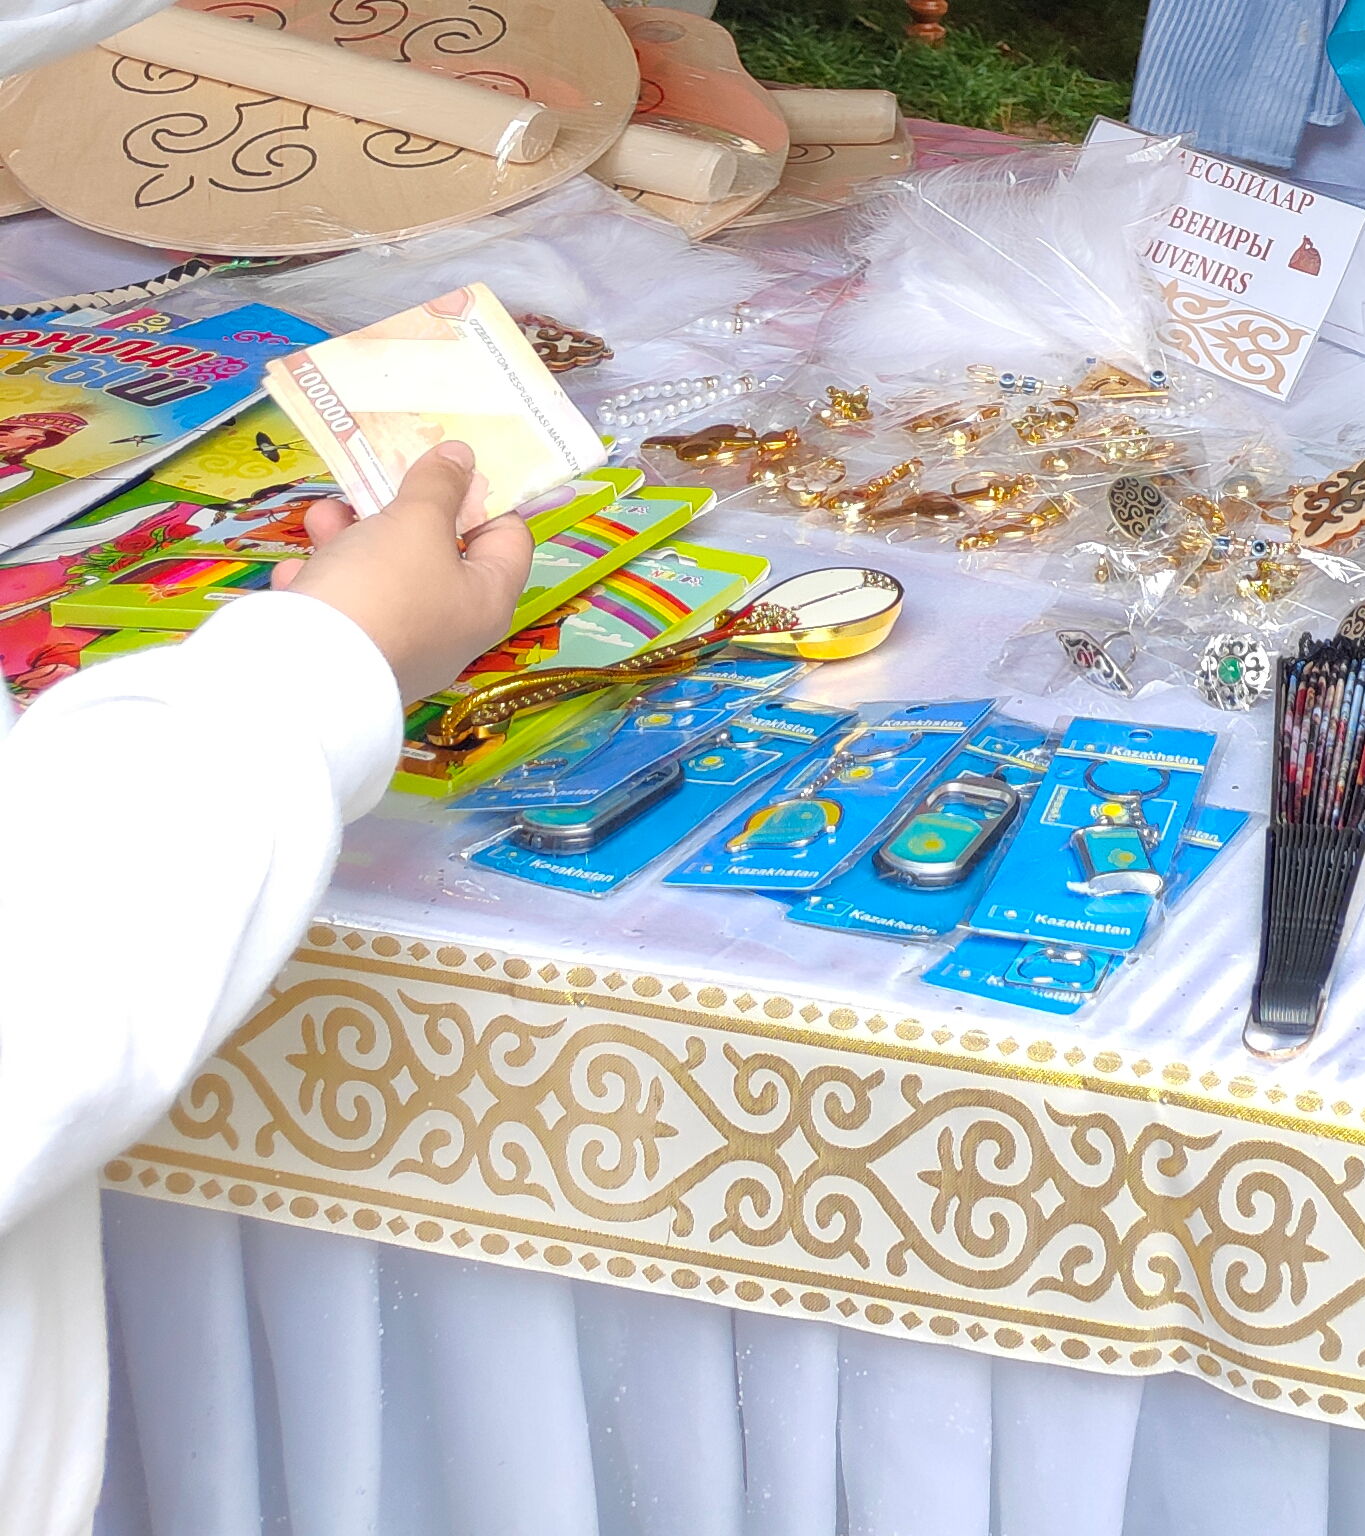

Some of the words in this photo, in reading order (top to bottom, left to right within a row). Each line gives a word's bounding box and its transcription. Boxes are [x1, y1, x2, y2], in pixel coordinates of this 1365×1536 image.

[1184, 154, 1315, 215] ЕСЫЙЛАР
[1168, 206, 1275, 261] ВЕНИРЫ
[1146, 239, 1253, 295] UVENIRS
[293, 362, 354, 433] 100000
[882, 718, 965, 729] Kazakhstan
[1111, 745, 1199, 766] Kazakhstan
[529, 859, 615, 883] Kazakhstan
[727, 866, 820, 879] Kazakhstan
[850, 908, 938, 936] Kazakhstan
[1034, 913, 1131, 936] Kazakhstan
